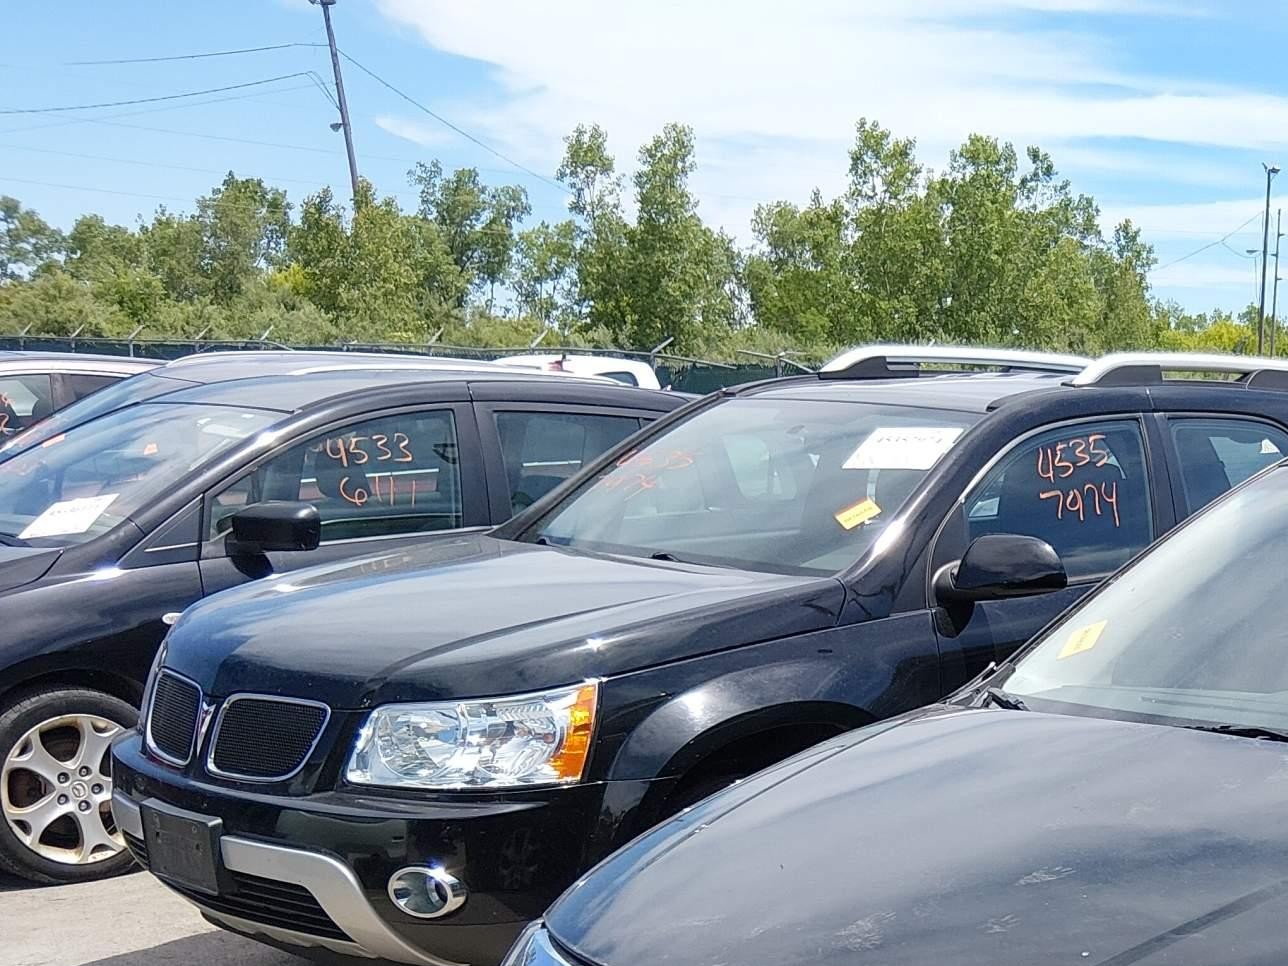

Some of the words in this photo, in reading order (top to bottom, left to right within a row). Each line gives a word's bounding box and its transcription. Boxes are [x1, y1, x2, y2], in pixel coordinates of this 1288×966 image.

[326, 432, 413, 467] 4533
[1038, 434, 1107, 483] 4535
[340, 476, 416, 507] 6111
[1039, 481, 1120, 528] 7974
